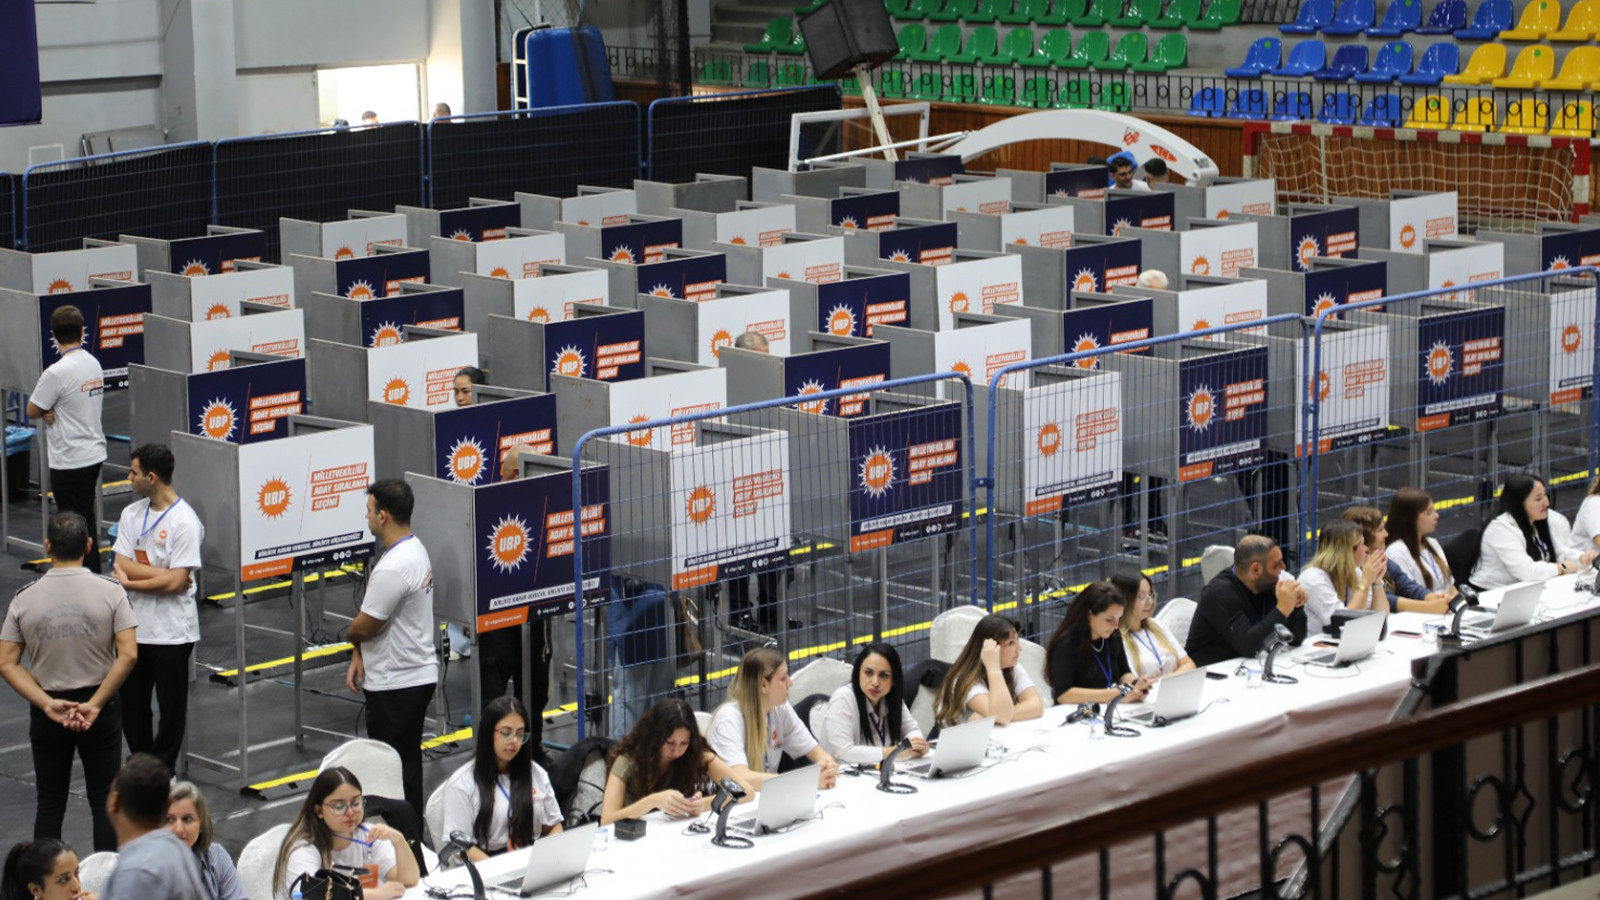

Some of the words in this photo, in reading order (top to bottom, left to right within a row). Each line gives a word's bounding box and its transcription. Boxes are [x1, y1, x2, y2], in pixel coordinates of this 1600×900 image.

[562, 361, 579, 374] UBP
[209, 415, 229, 430] UBP
[457, 455, 477, 471] UBP
[313, 464, 365, 481] MİLLETVEKİLLİĞİ
[313, 484, 333, 495] ADAY
[333, 477, 367, 492] SIRALAMA
[264, 490, 286, 507] UBP
[314, 497, 338, 510] SEÇİMİ
[550, 528, 568, 539] ADAY
[500, 535, 521, 552] UBP
[549, 541, 574, 556] SEÇİMİ
